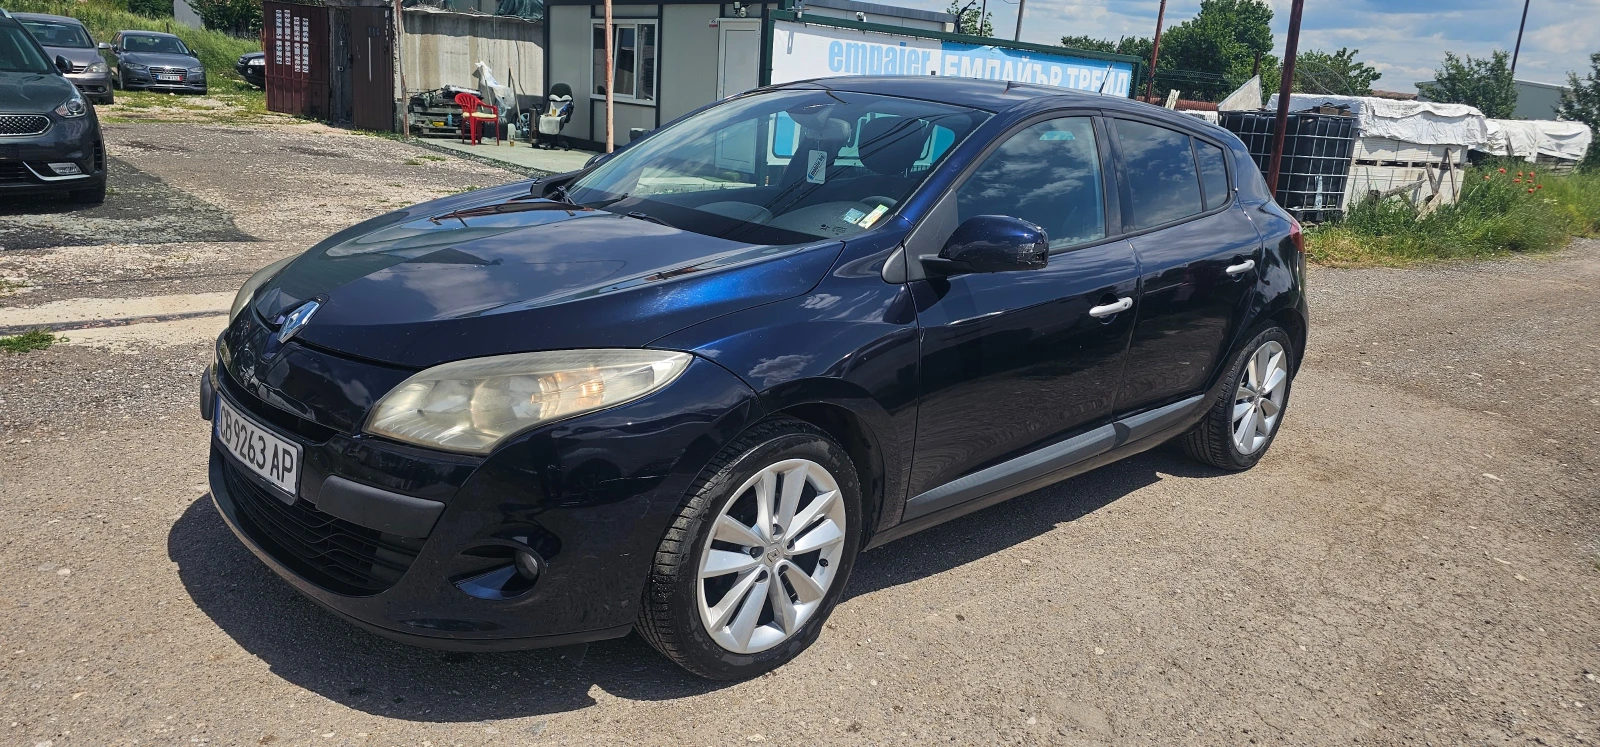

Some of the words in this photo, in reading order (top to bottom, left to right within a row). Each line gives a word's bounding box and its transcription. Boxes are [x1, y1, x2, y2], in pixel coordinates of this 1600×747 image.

[829, 41, 931, 75] empaier
[945, 55, 1062, 86] ЕМПАЙЪР
[1067, 66, 1128, 98] ТРЕЙД
[271, 444, 294, 483] AP
